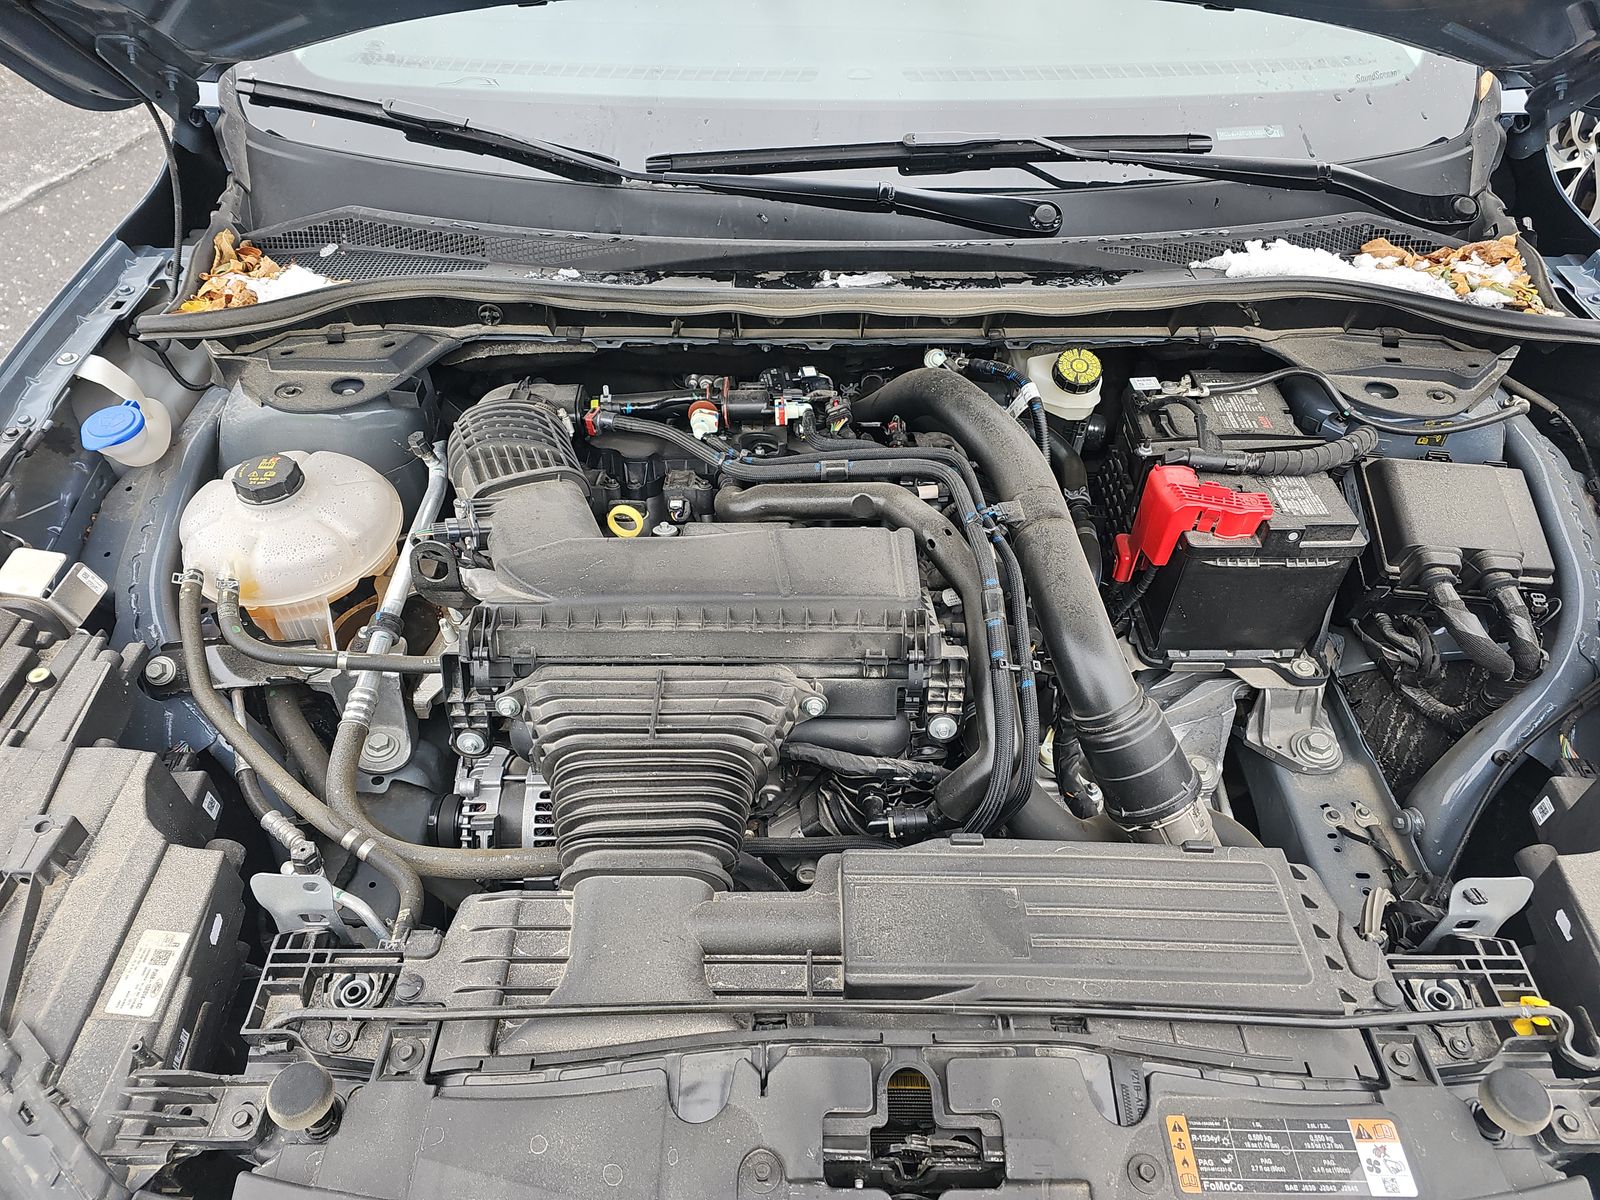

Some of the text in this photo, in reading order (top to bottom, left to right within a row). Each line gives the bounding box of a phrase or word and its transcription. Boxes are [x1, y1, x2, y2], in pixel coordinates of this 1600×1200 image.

[1191, 1134, 1220, 1143] R-1234yf
[1264, 1134, 1272, 1143] kg
[1325, 1134, 1334, 1143] kg
[1198, 1158, 1214, 1167] PAG
[1260, 1157, 1273, 1165] PAG
[1202, 1180, 1244, 1191] FoMoCo
